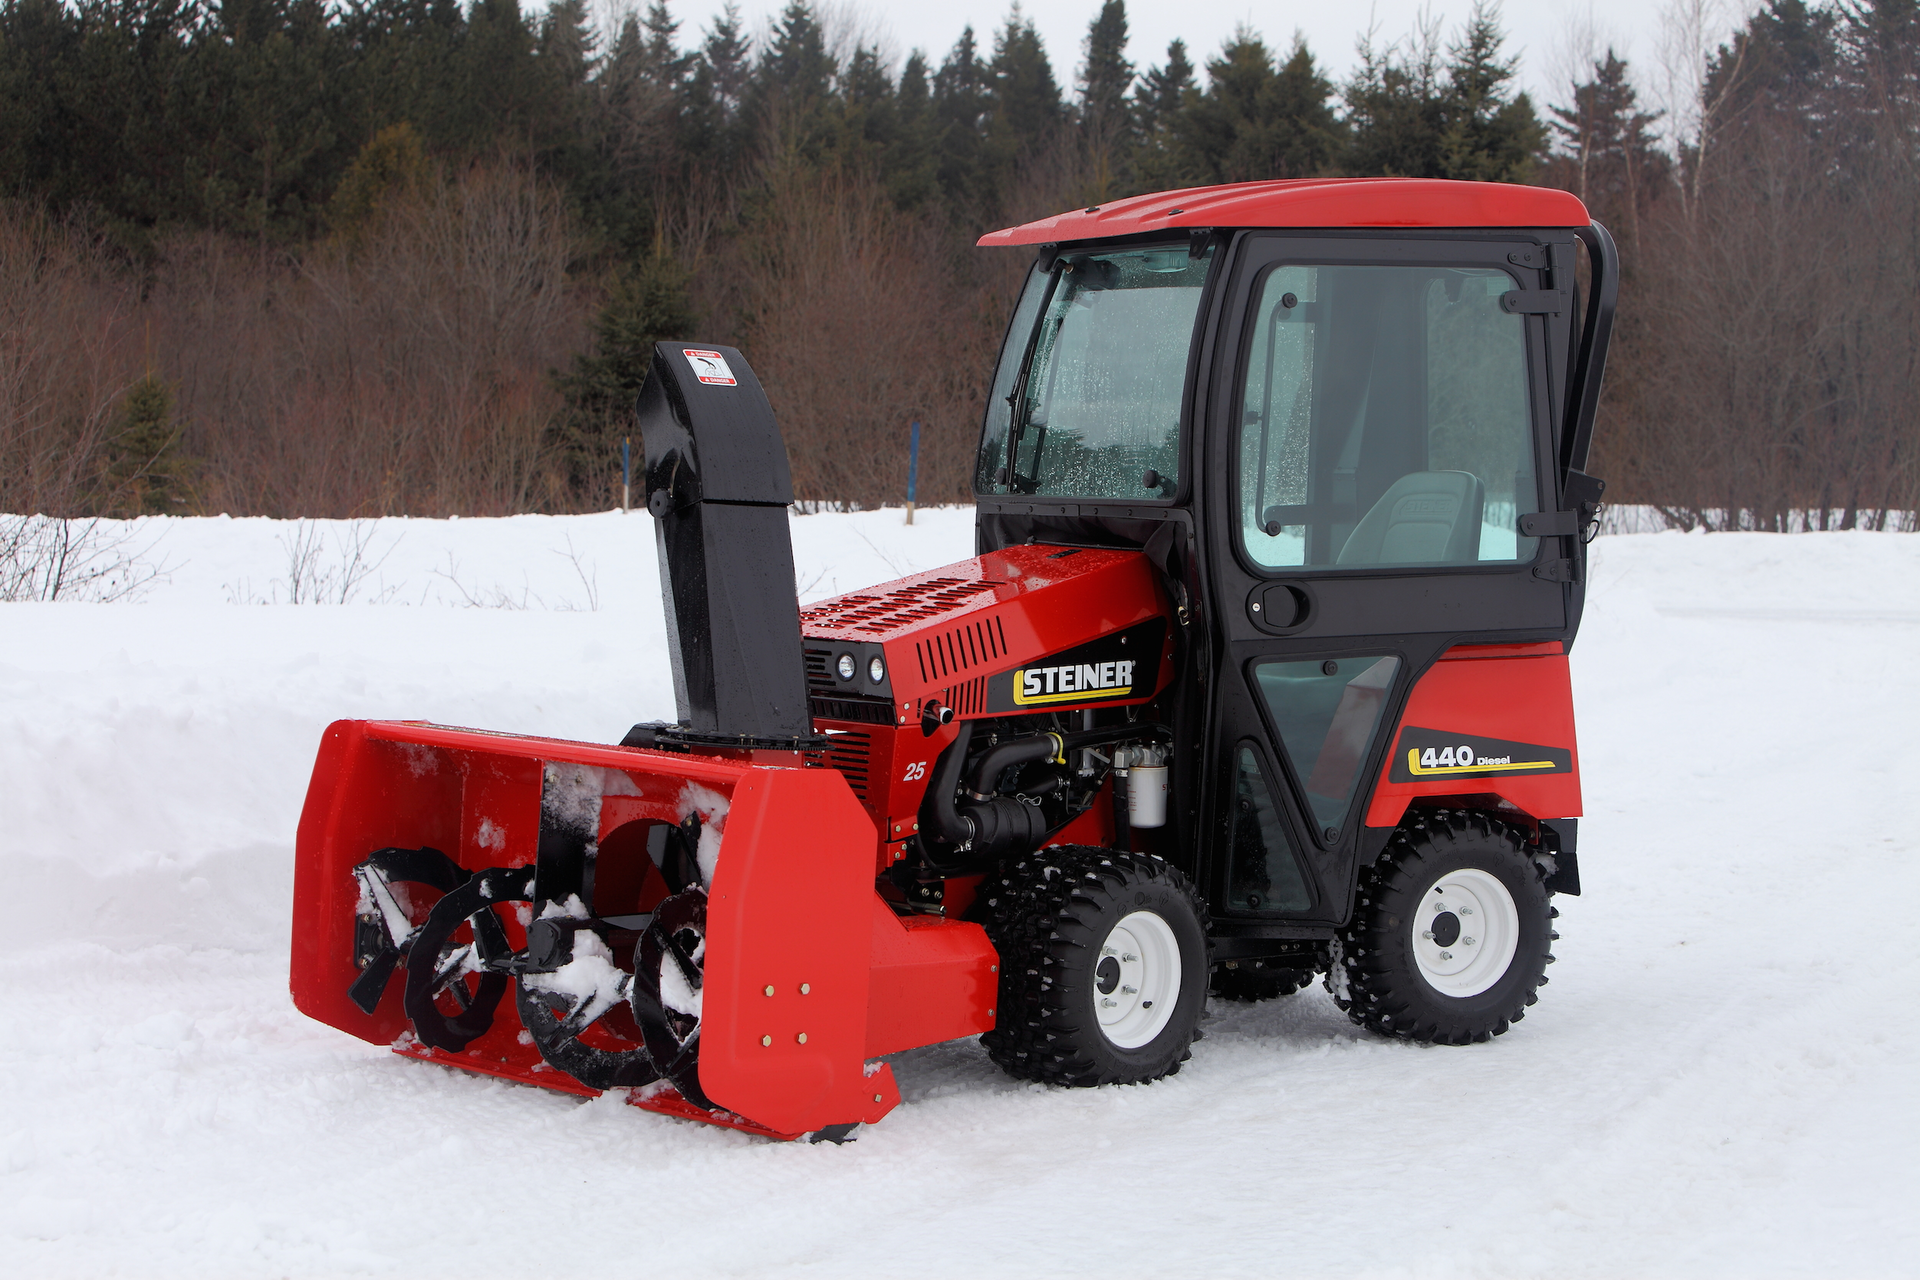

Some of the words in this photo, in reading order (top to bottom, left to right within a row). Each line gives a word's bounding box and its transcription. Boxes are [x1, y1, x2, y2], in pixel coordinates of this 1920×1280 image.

[1023, 660, 1132, 696] STEINER
[1420, 745, 1474, 768] 440
[1476, 756, 1511, 766] Diesel
[902, 761, 927, 782] 25
